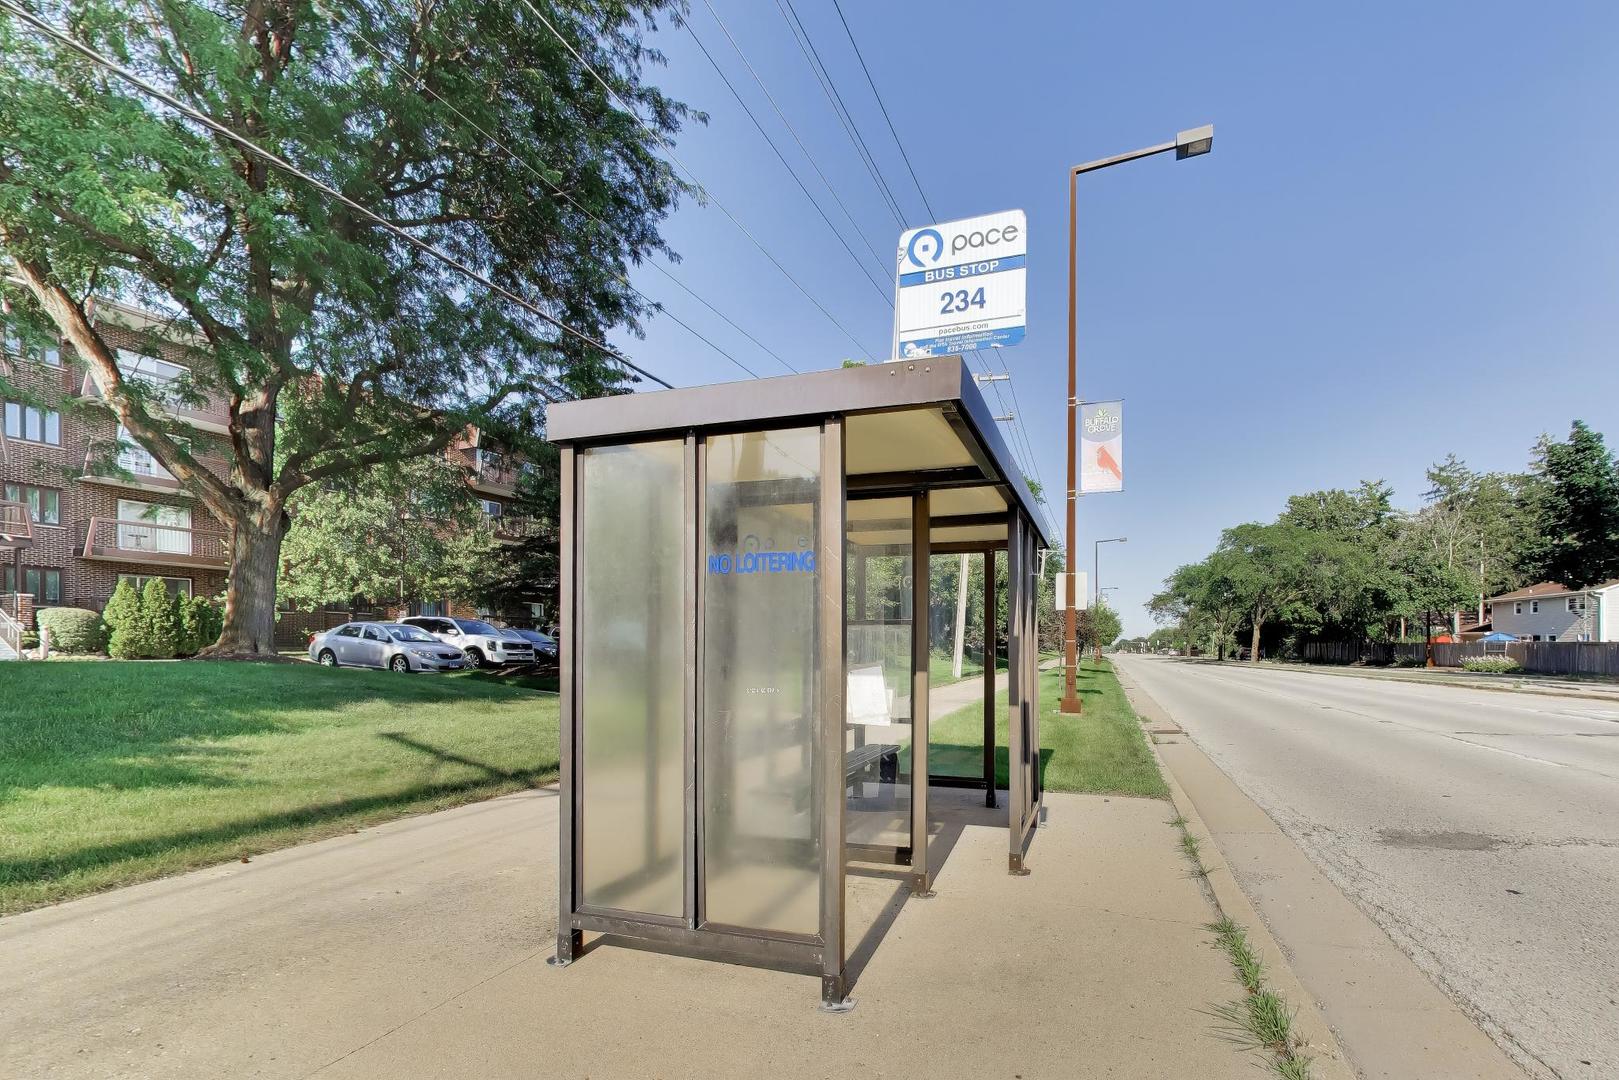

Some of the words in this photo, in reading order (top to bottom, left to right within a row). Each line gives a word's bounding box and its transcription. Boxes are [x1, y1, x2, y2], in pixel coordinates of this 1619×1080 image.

[951, 225, 1018, 256] pace
[925, 268, 955, 282] BUS
[960, 260, 999, 276] STOP
[940, 287, 986, 315] 234
[938, 323, 988, 336] pacebus.com
[709, 554, 731, 575] NO
[735, 551, 816, 574] LOITERING
